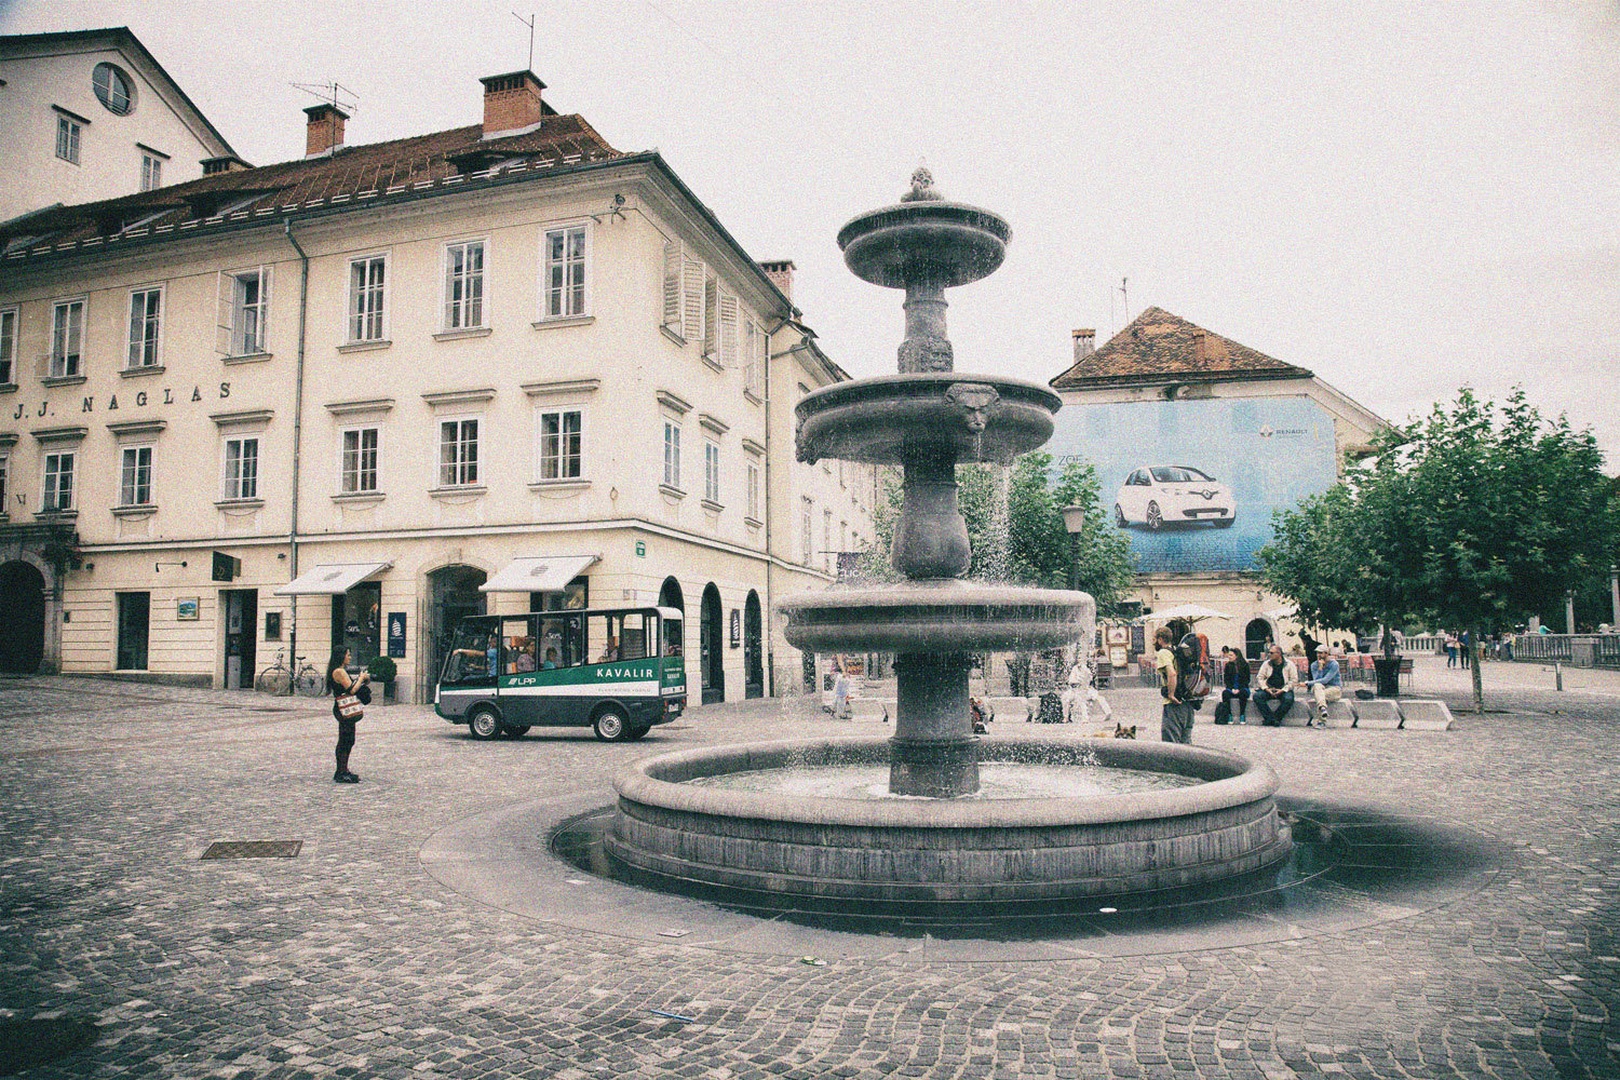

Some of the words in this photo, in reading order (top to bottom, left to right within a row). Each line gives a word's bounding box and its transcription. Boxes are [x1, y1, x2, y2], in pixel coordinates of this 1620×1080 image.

[81, 382, 231, 413] NAGLAS
[596, 668, 653, 678] KAVALIR
[517, 677, 537, 685] LPP
